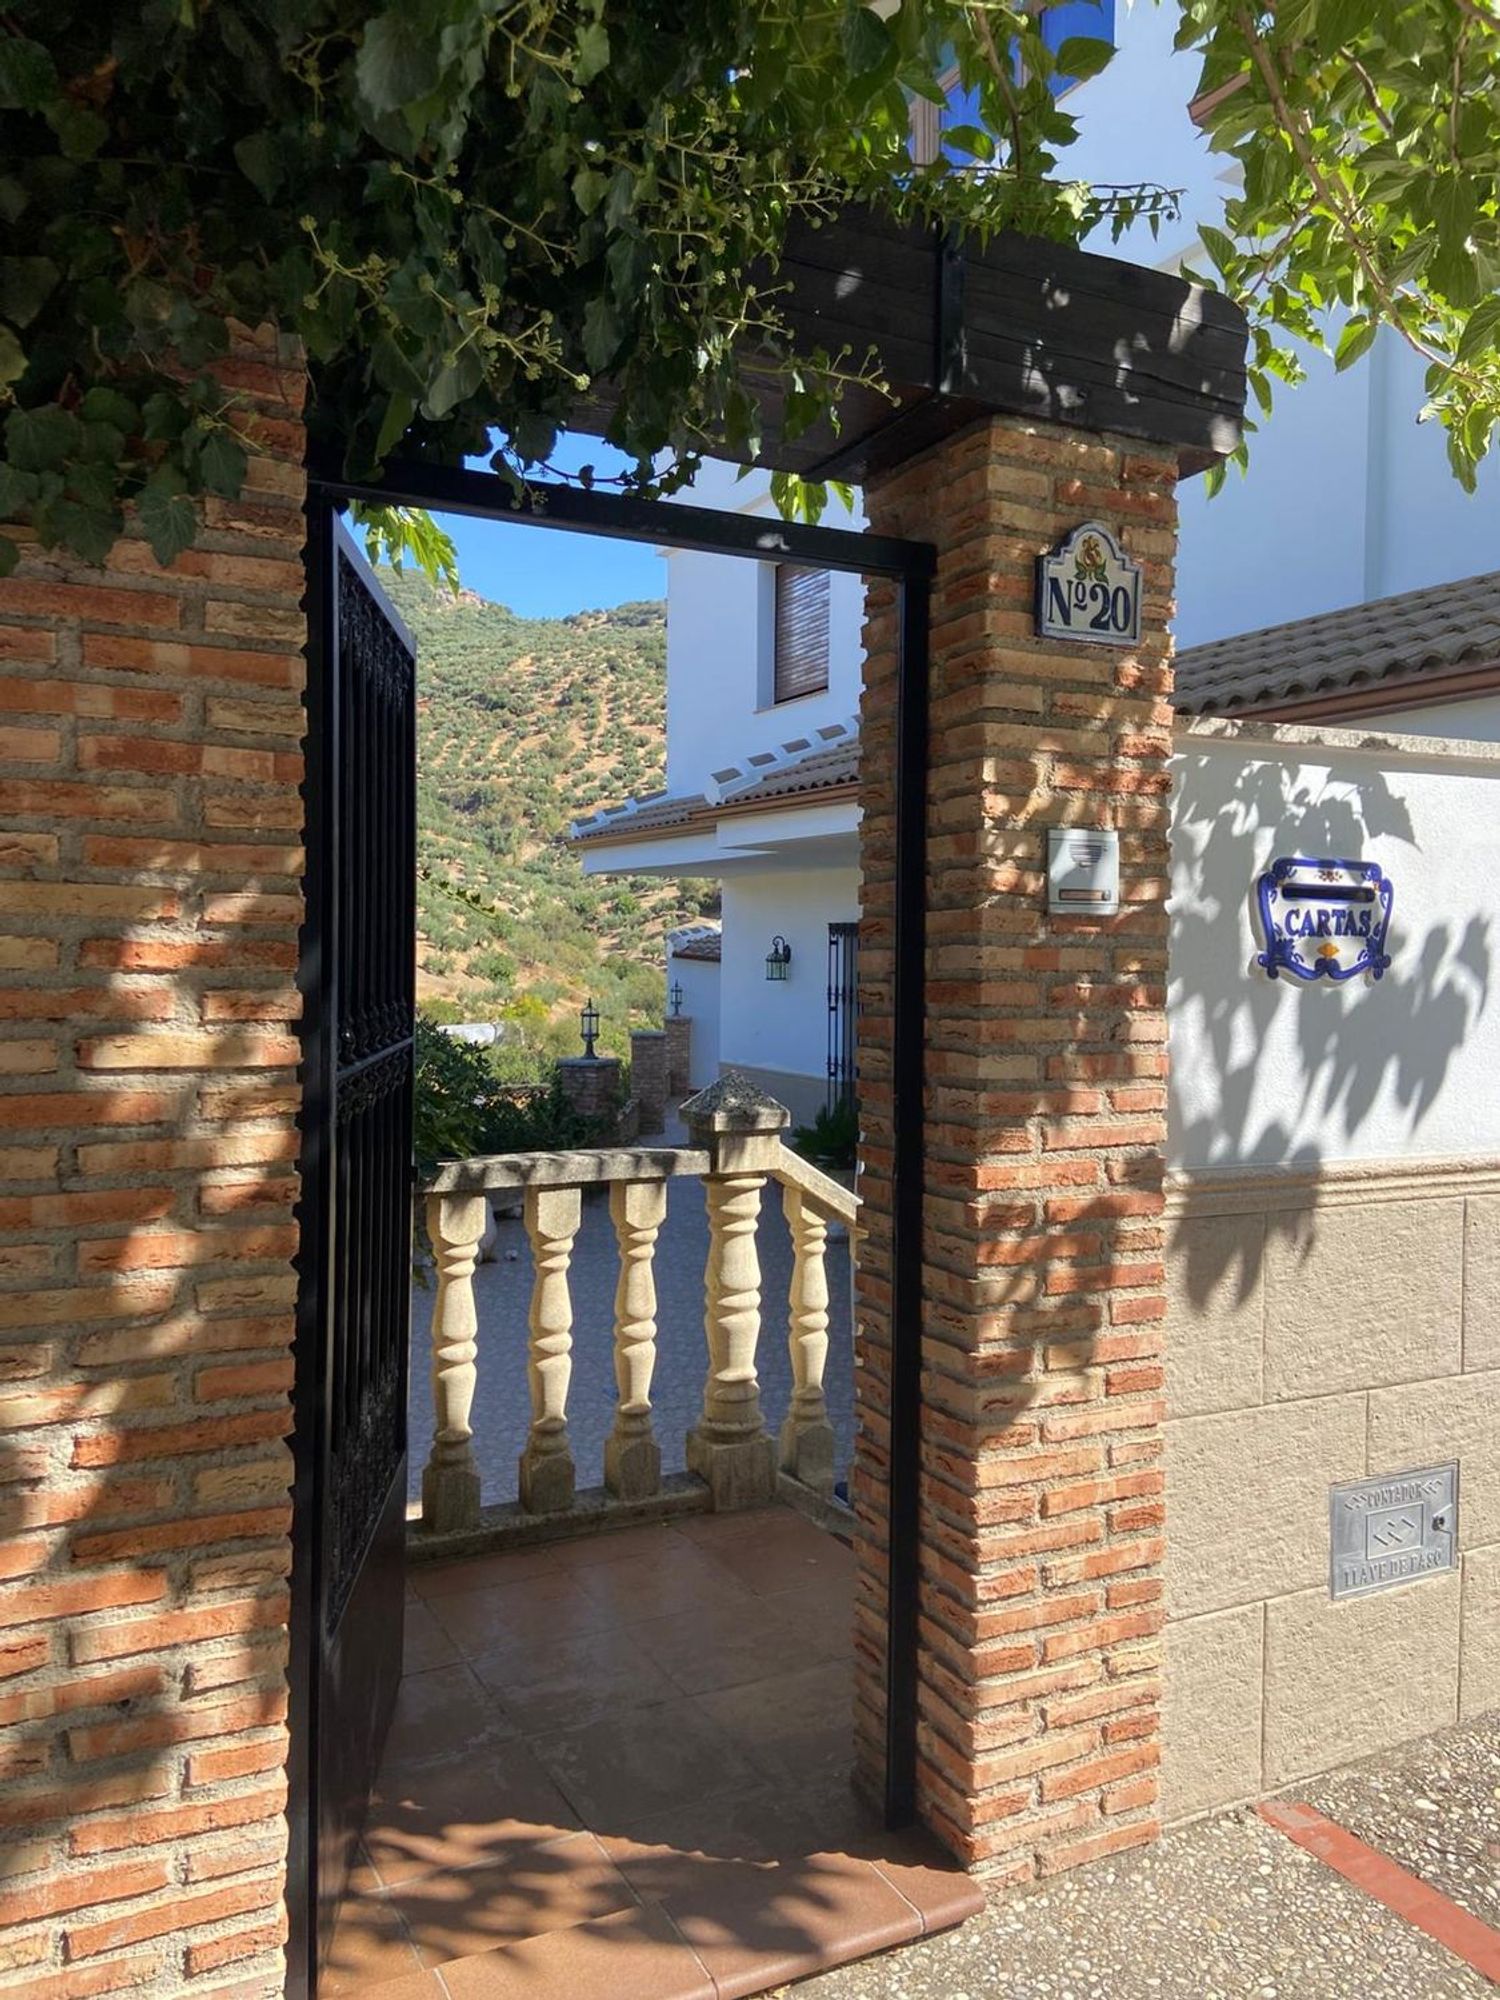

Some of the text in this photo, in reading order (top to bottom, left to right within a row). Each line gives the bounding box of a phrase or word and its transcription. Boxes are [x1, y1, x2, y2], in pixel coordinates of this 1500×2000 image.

[1089, 582, 1131, 632] 20
[1285, 908, 1372, 937] CARTAS
[1367, 1482, 1422, 1508] CONTADOR
[1344, 1548, 1442, 1587] LLAVE DE PASO
